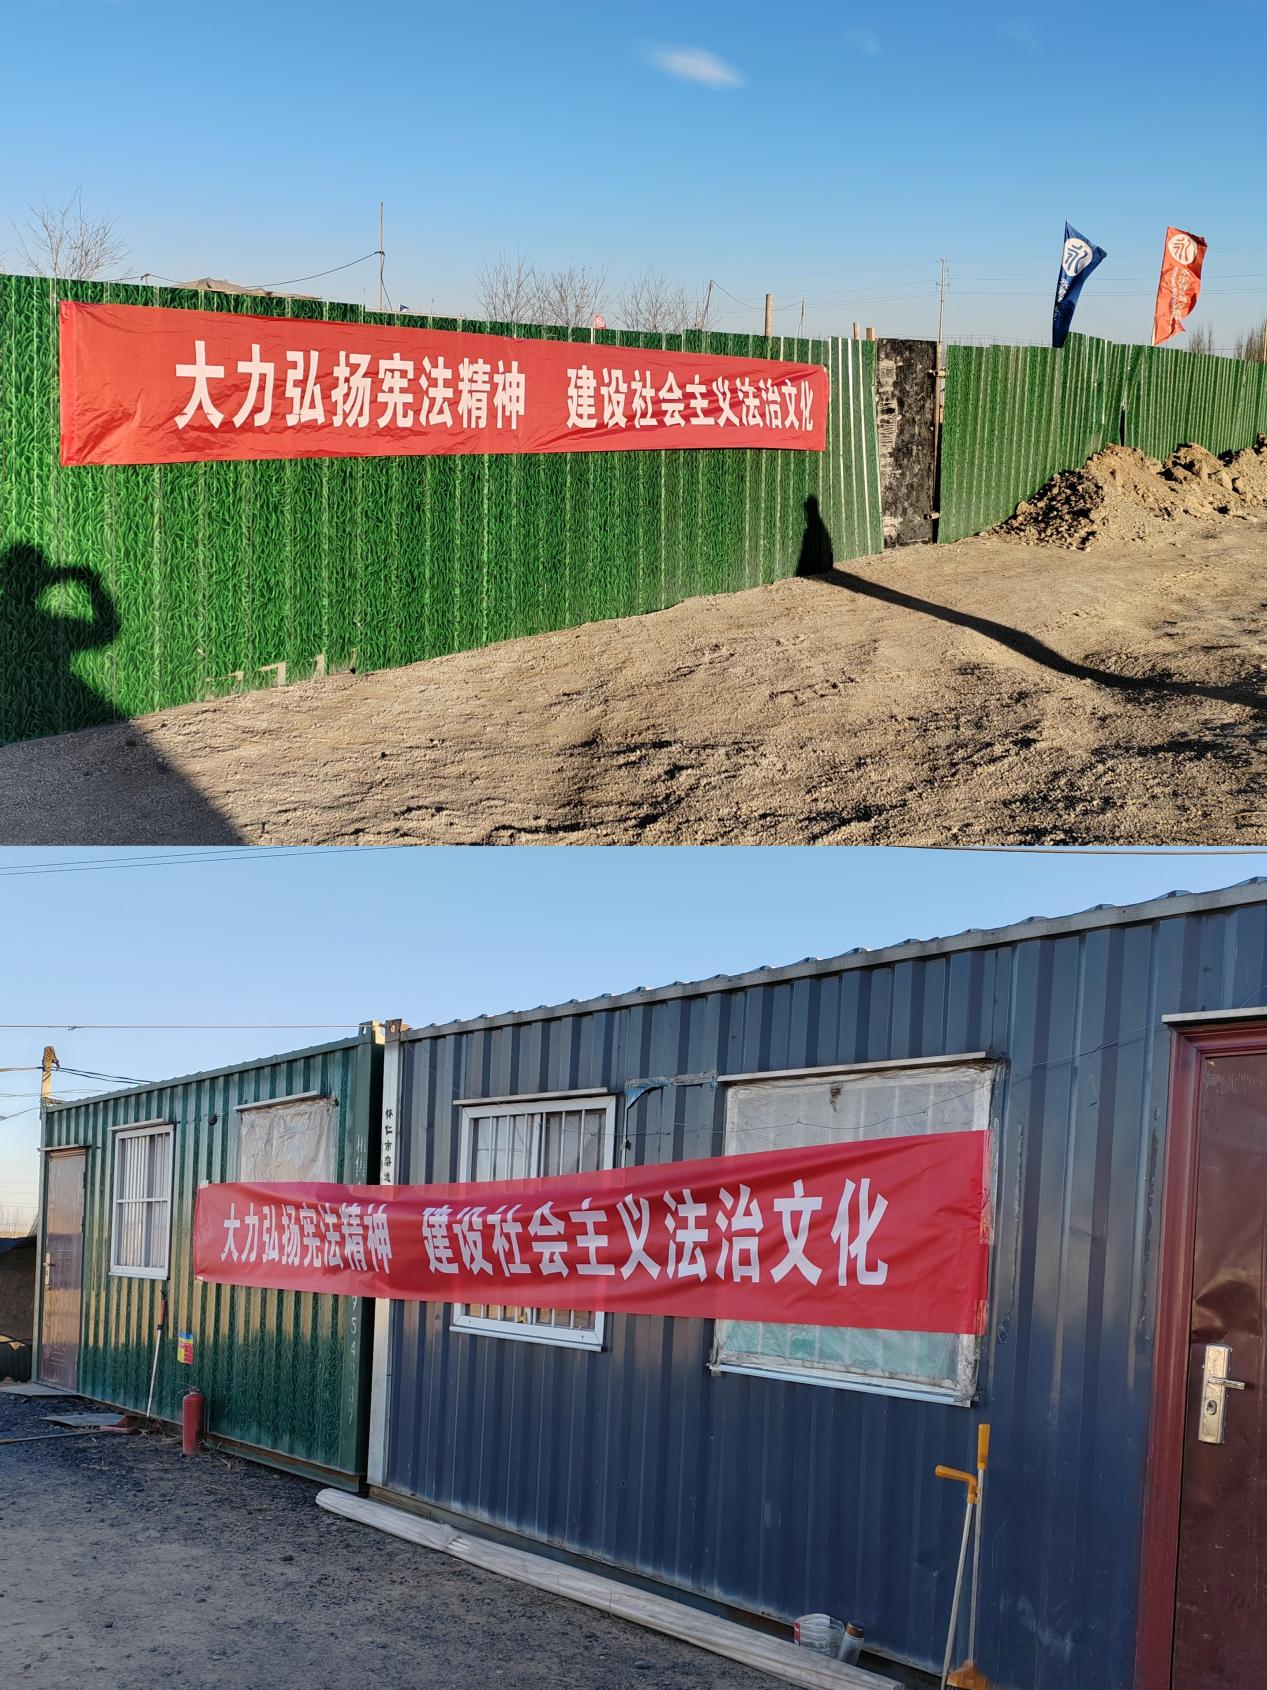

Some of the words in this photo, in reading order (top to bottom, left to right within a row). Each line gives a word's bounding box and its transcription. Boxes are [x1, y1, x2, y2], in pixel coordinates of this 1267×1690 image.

[175, 341, 525, 430] 大力弘扬宪法精神
[567, 365, 813, 431] 建设社会主义法治文化
[220, 1202, 392, 1275] 大力弘扬宪法精神
[423, 1176, 889, 1287] 建设社会主义法治文化
